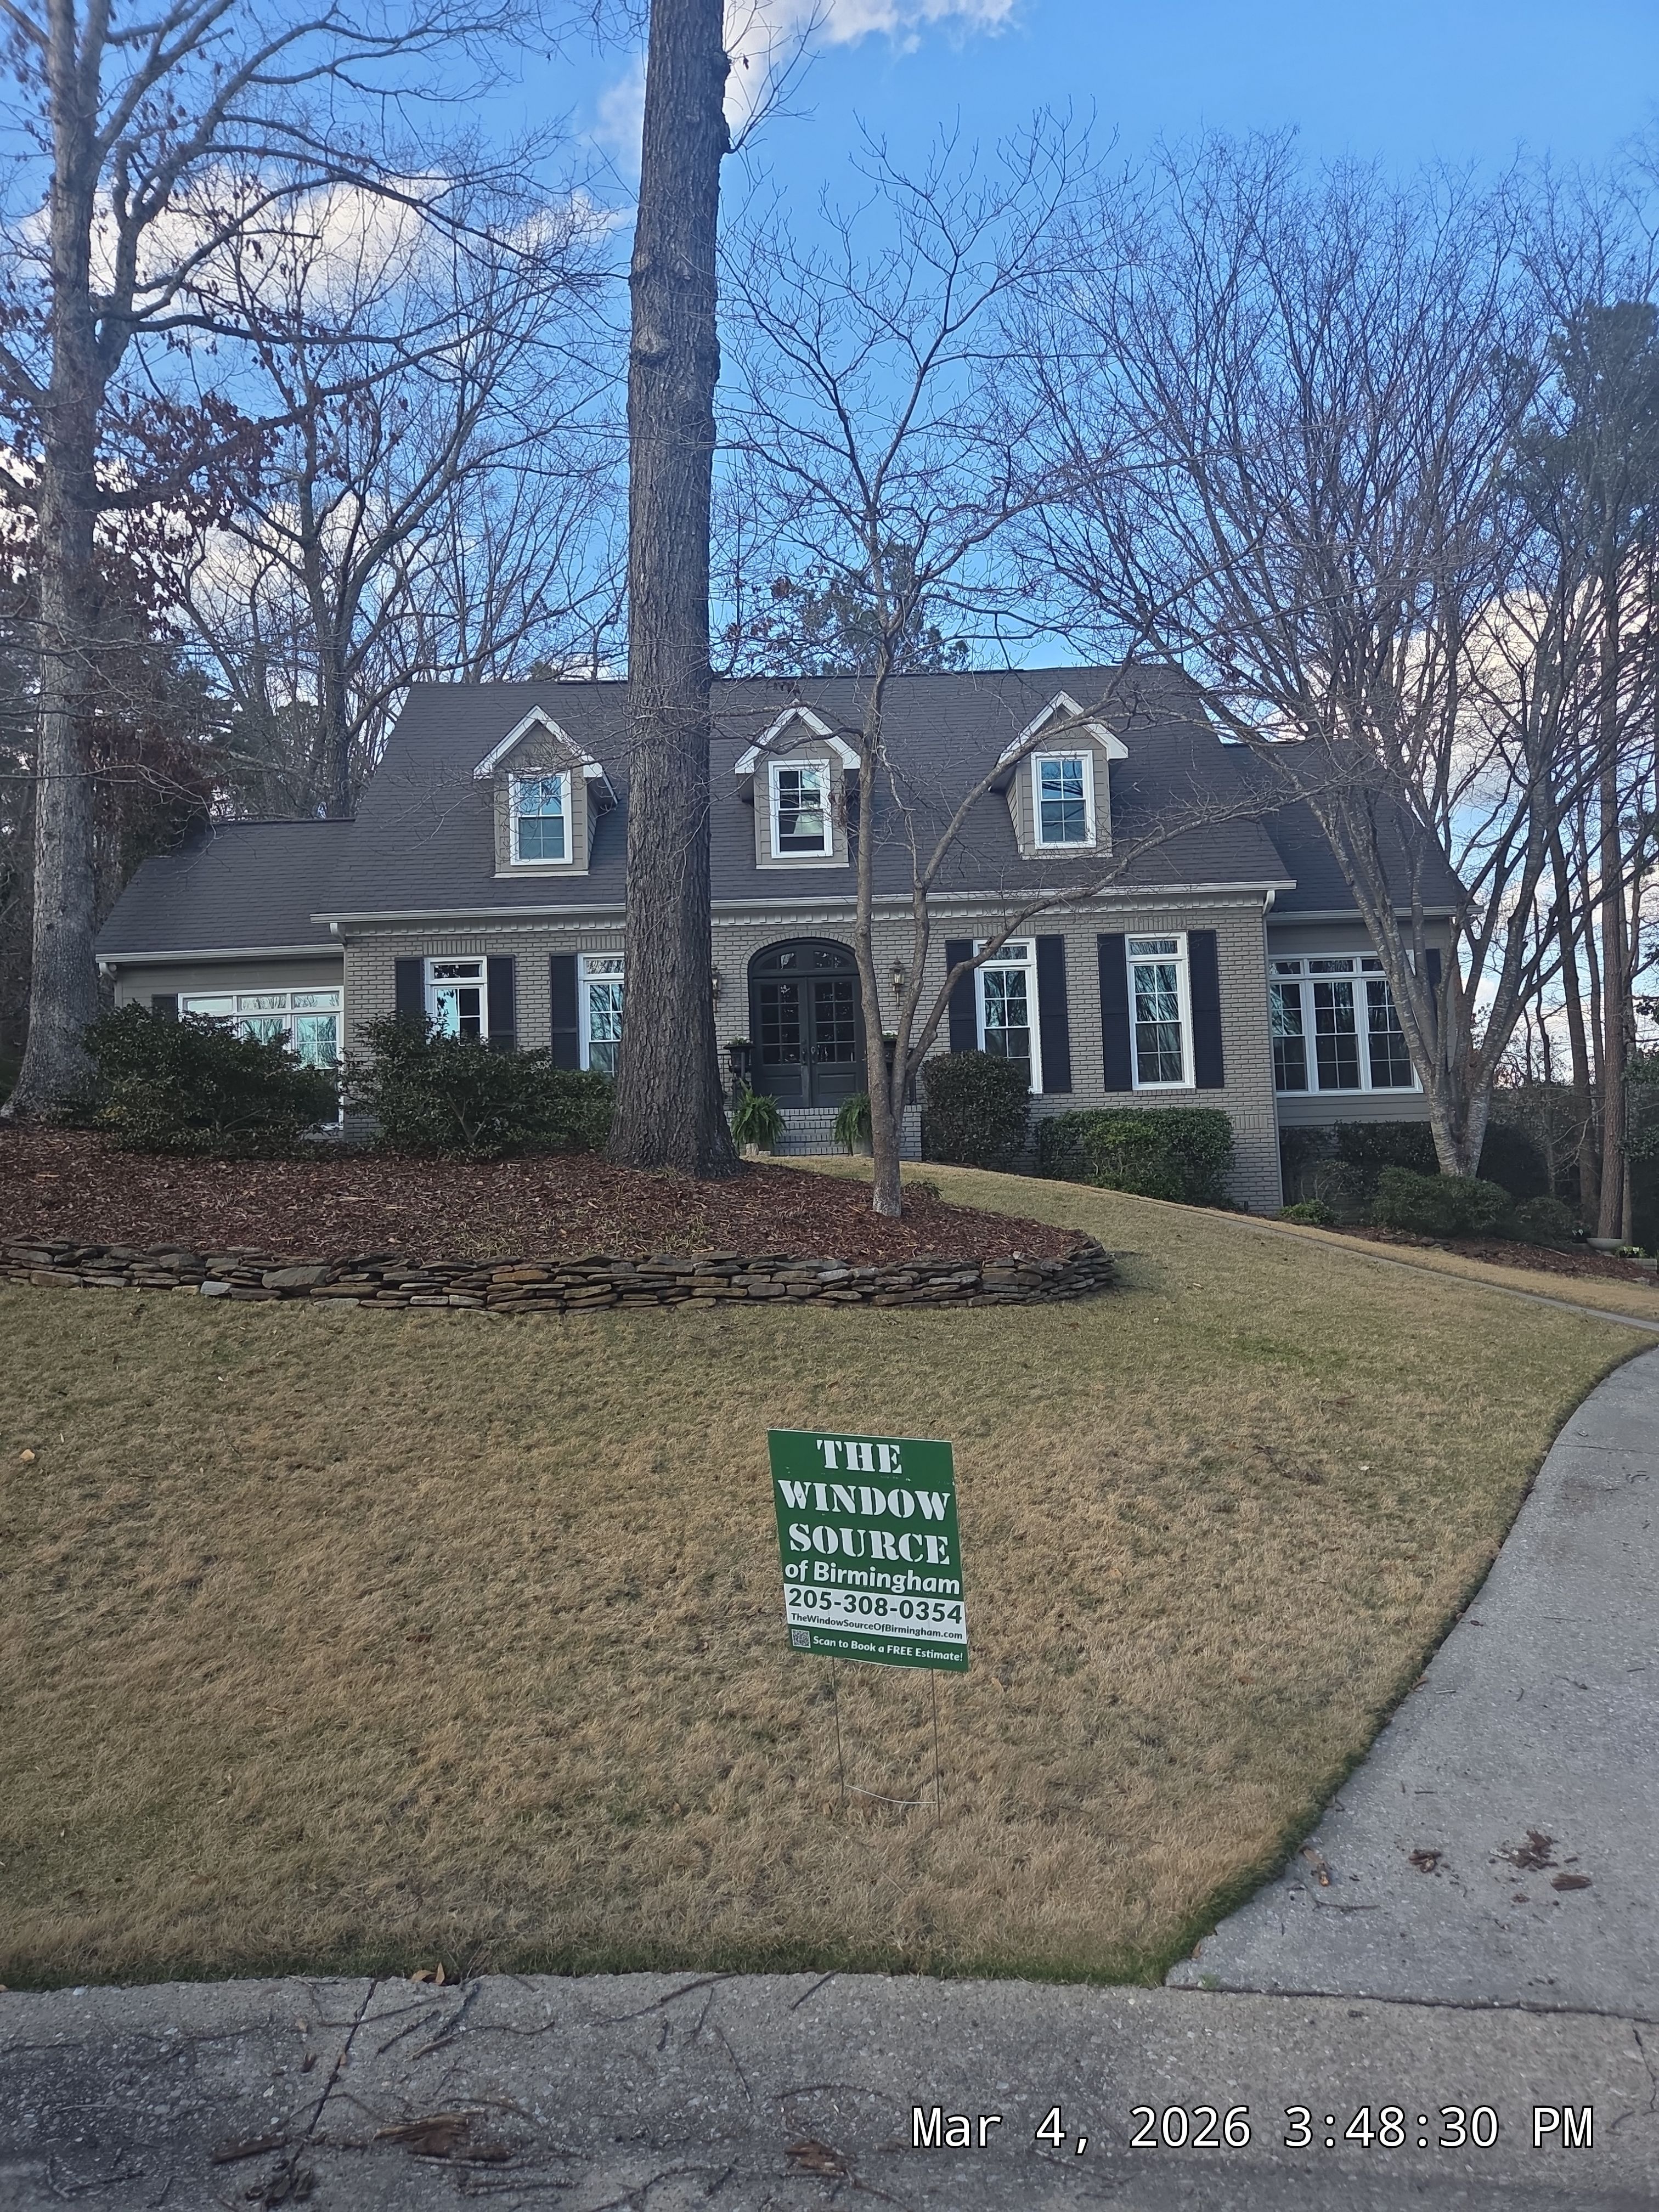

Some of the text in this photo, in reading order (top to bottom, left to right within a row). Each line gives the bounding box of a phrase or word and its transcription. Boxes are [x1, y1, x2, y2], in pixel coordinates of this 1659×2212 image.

[816, 1439, 902, 1474] THE
[777, 1480, 951, 1521] WINDOW
[788, 1523, 950, 1565] SOURCE
[785, 1560, 960, 1594] of Birmingham
[788, 1588, 962, 1624] 205-308-0354
[791, 1612, 963, 1640] TheWindowSourceOfBirmingham.com
[813, 1635, 836, 1647] Scan
[838, 1639, 849, 1648] to
[851, 1640, 876, 1652] Book
[887, 1645, 913, 1656] FREE
[915, 1647, 963, 1662] Estimate!
